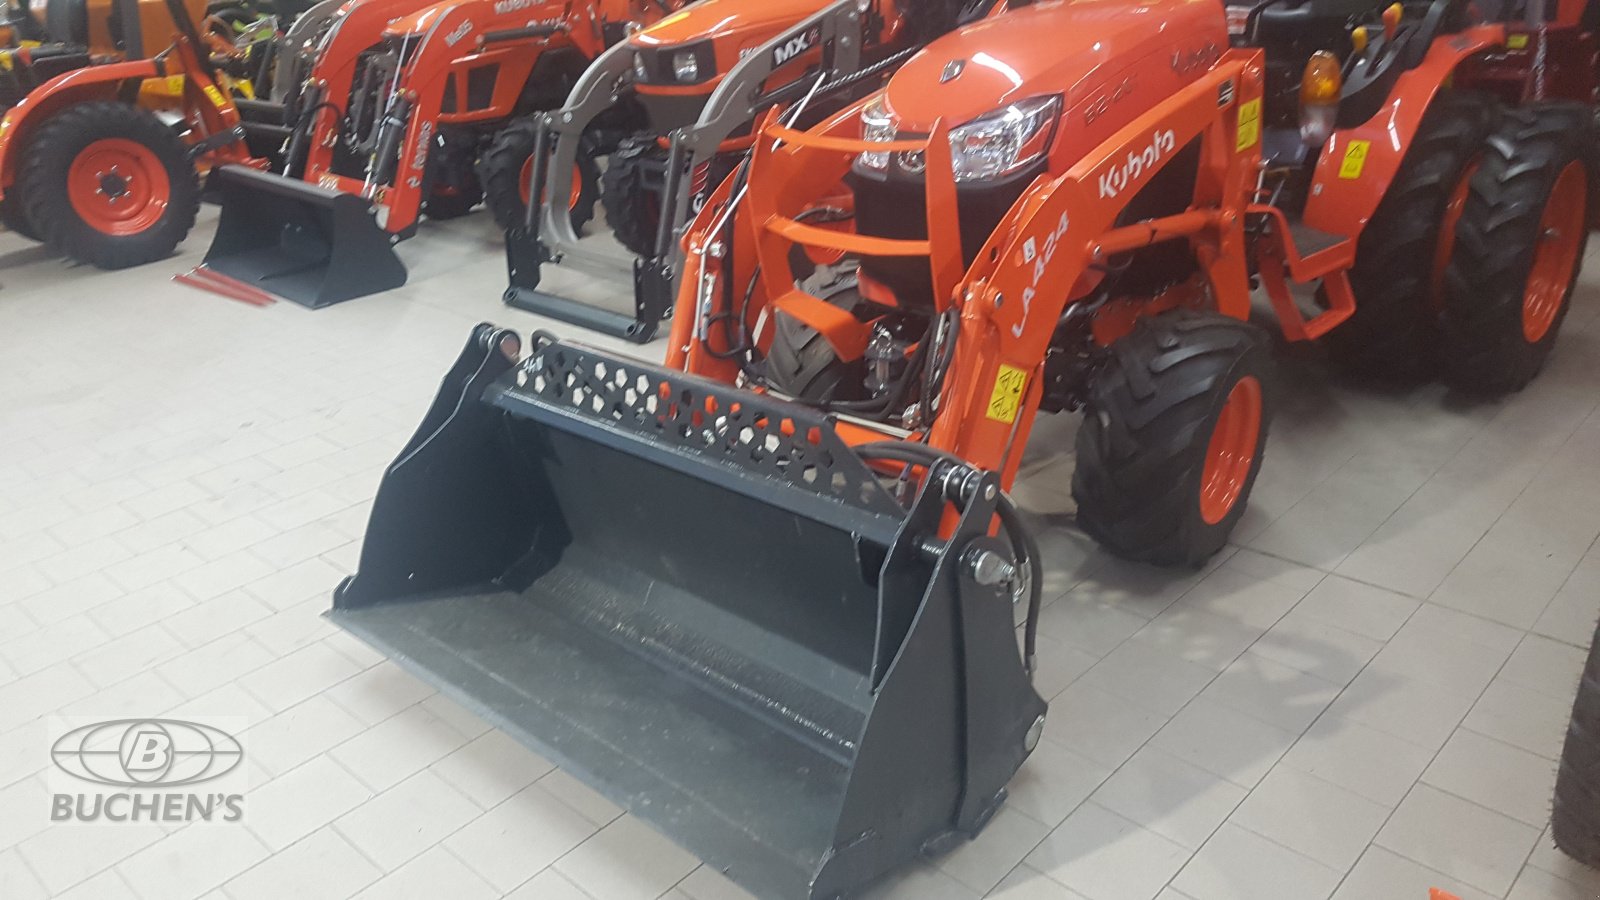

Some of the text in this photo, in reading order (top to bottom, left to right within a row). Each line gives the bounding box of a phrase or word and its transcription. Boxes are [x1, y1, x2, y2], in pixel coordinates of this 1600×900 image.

[774, 32, 808, 65] MX
[1099, 129, 1175, 199] Kubota
[1012, 209, 1069, 338] LA424
